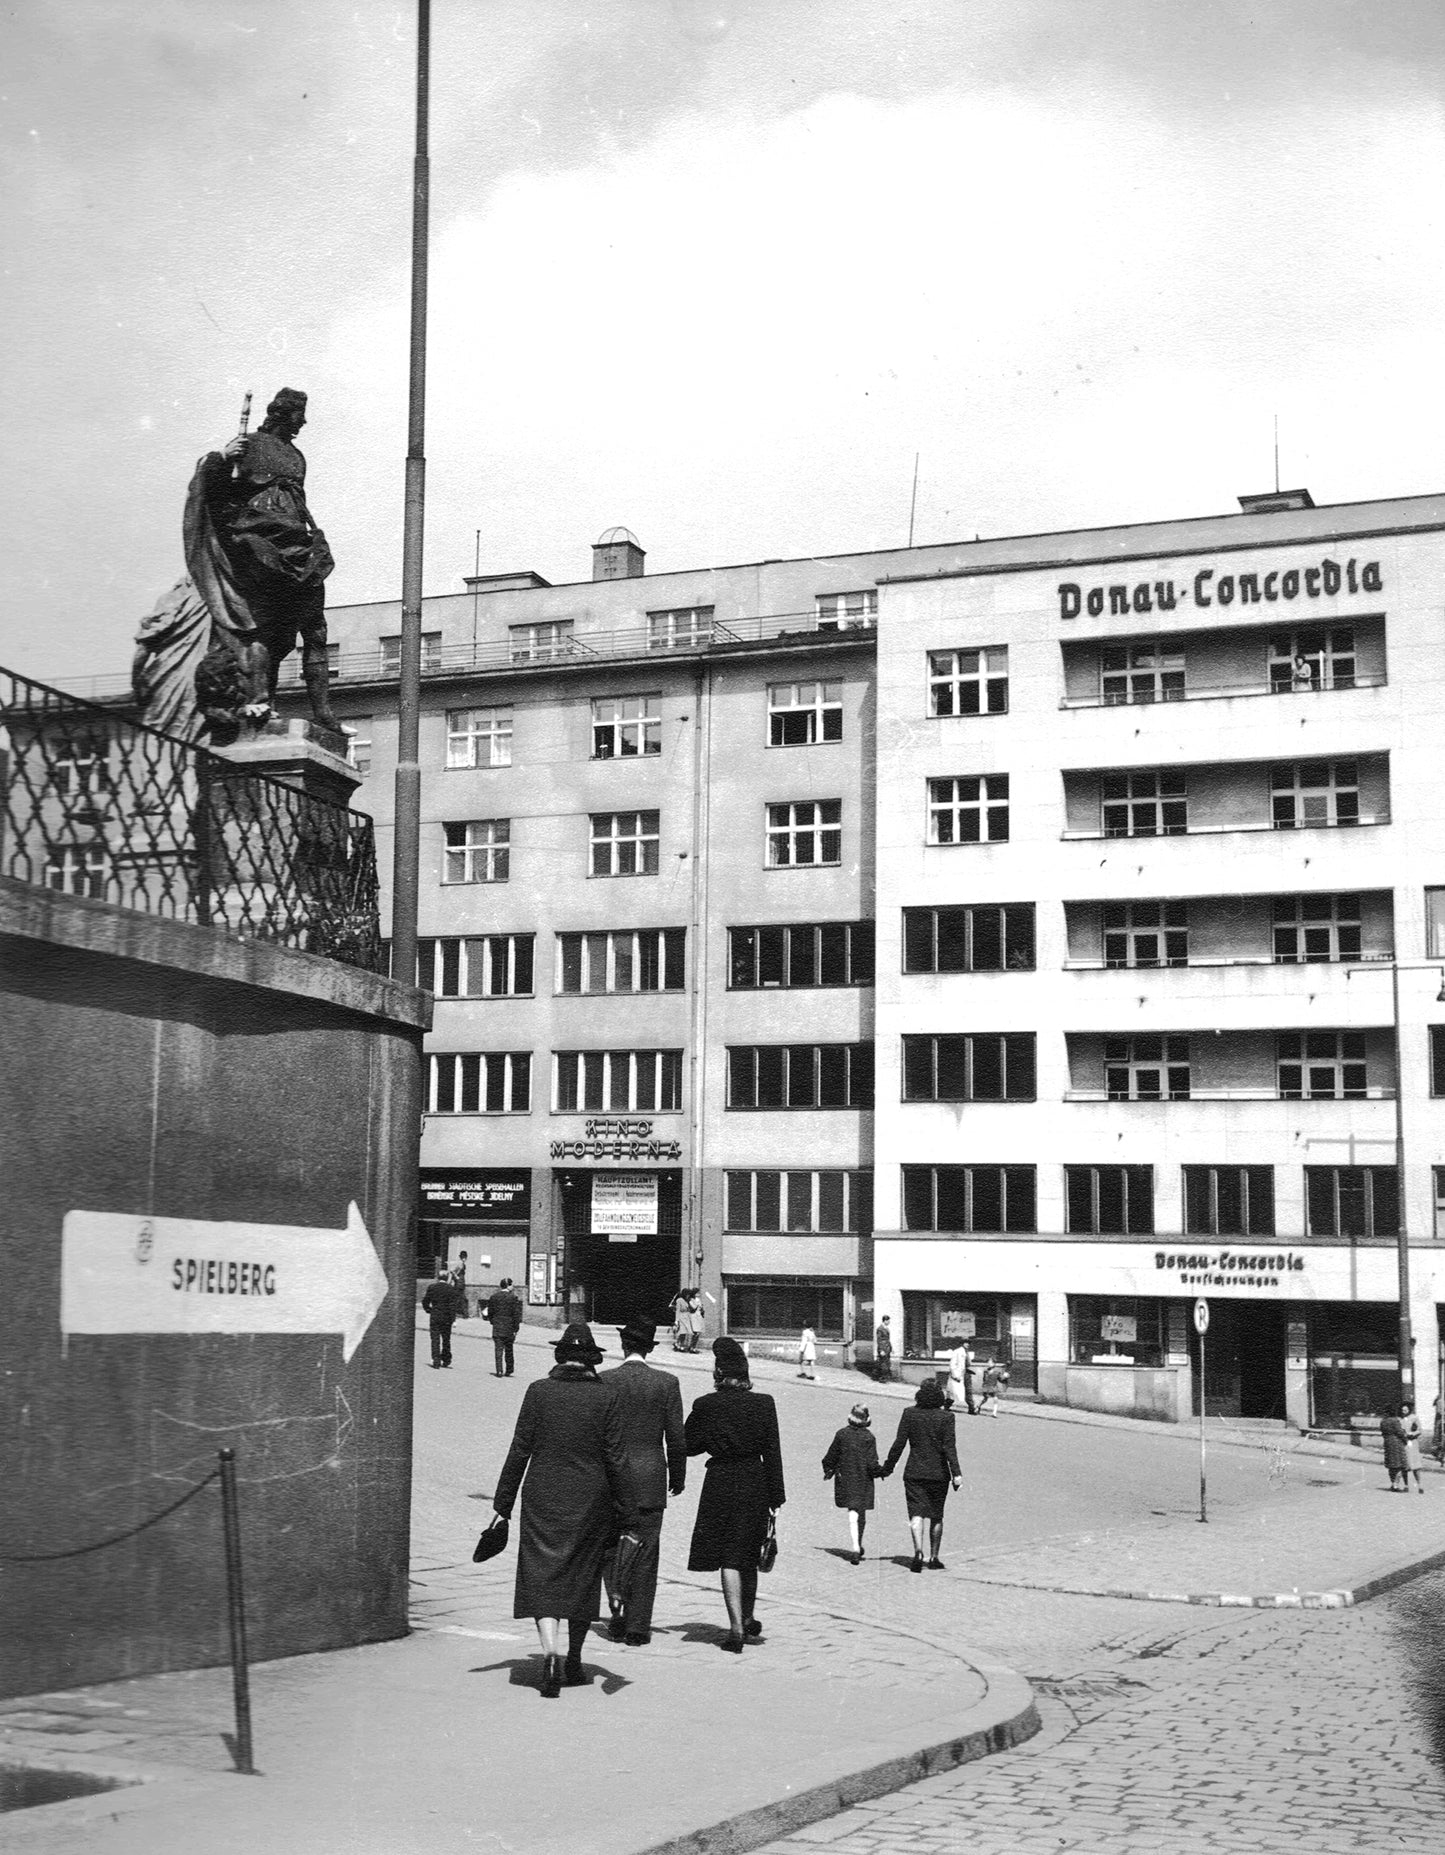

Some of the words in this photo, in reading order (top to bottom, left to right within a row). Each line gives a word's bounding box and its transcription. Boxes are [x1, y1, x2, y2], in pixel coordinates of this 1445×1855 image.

[586, 1119, 652, 1138] KINO
[551, 1140, 681, 1160] MODERNA
[172, 1258, 276, 1295] SPIELBERG
